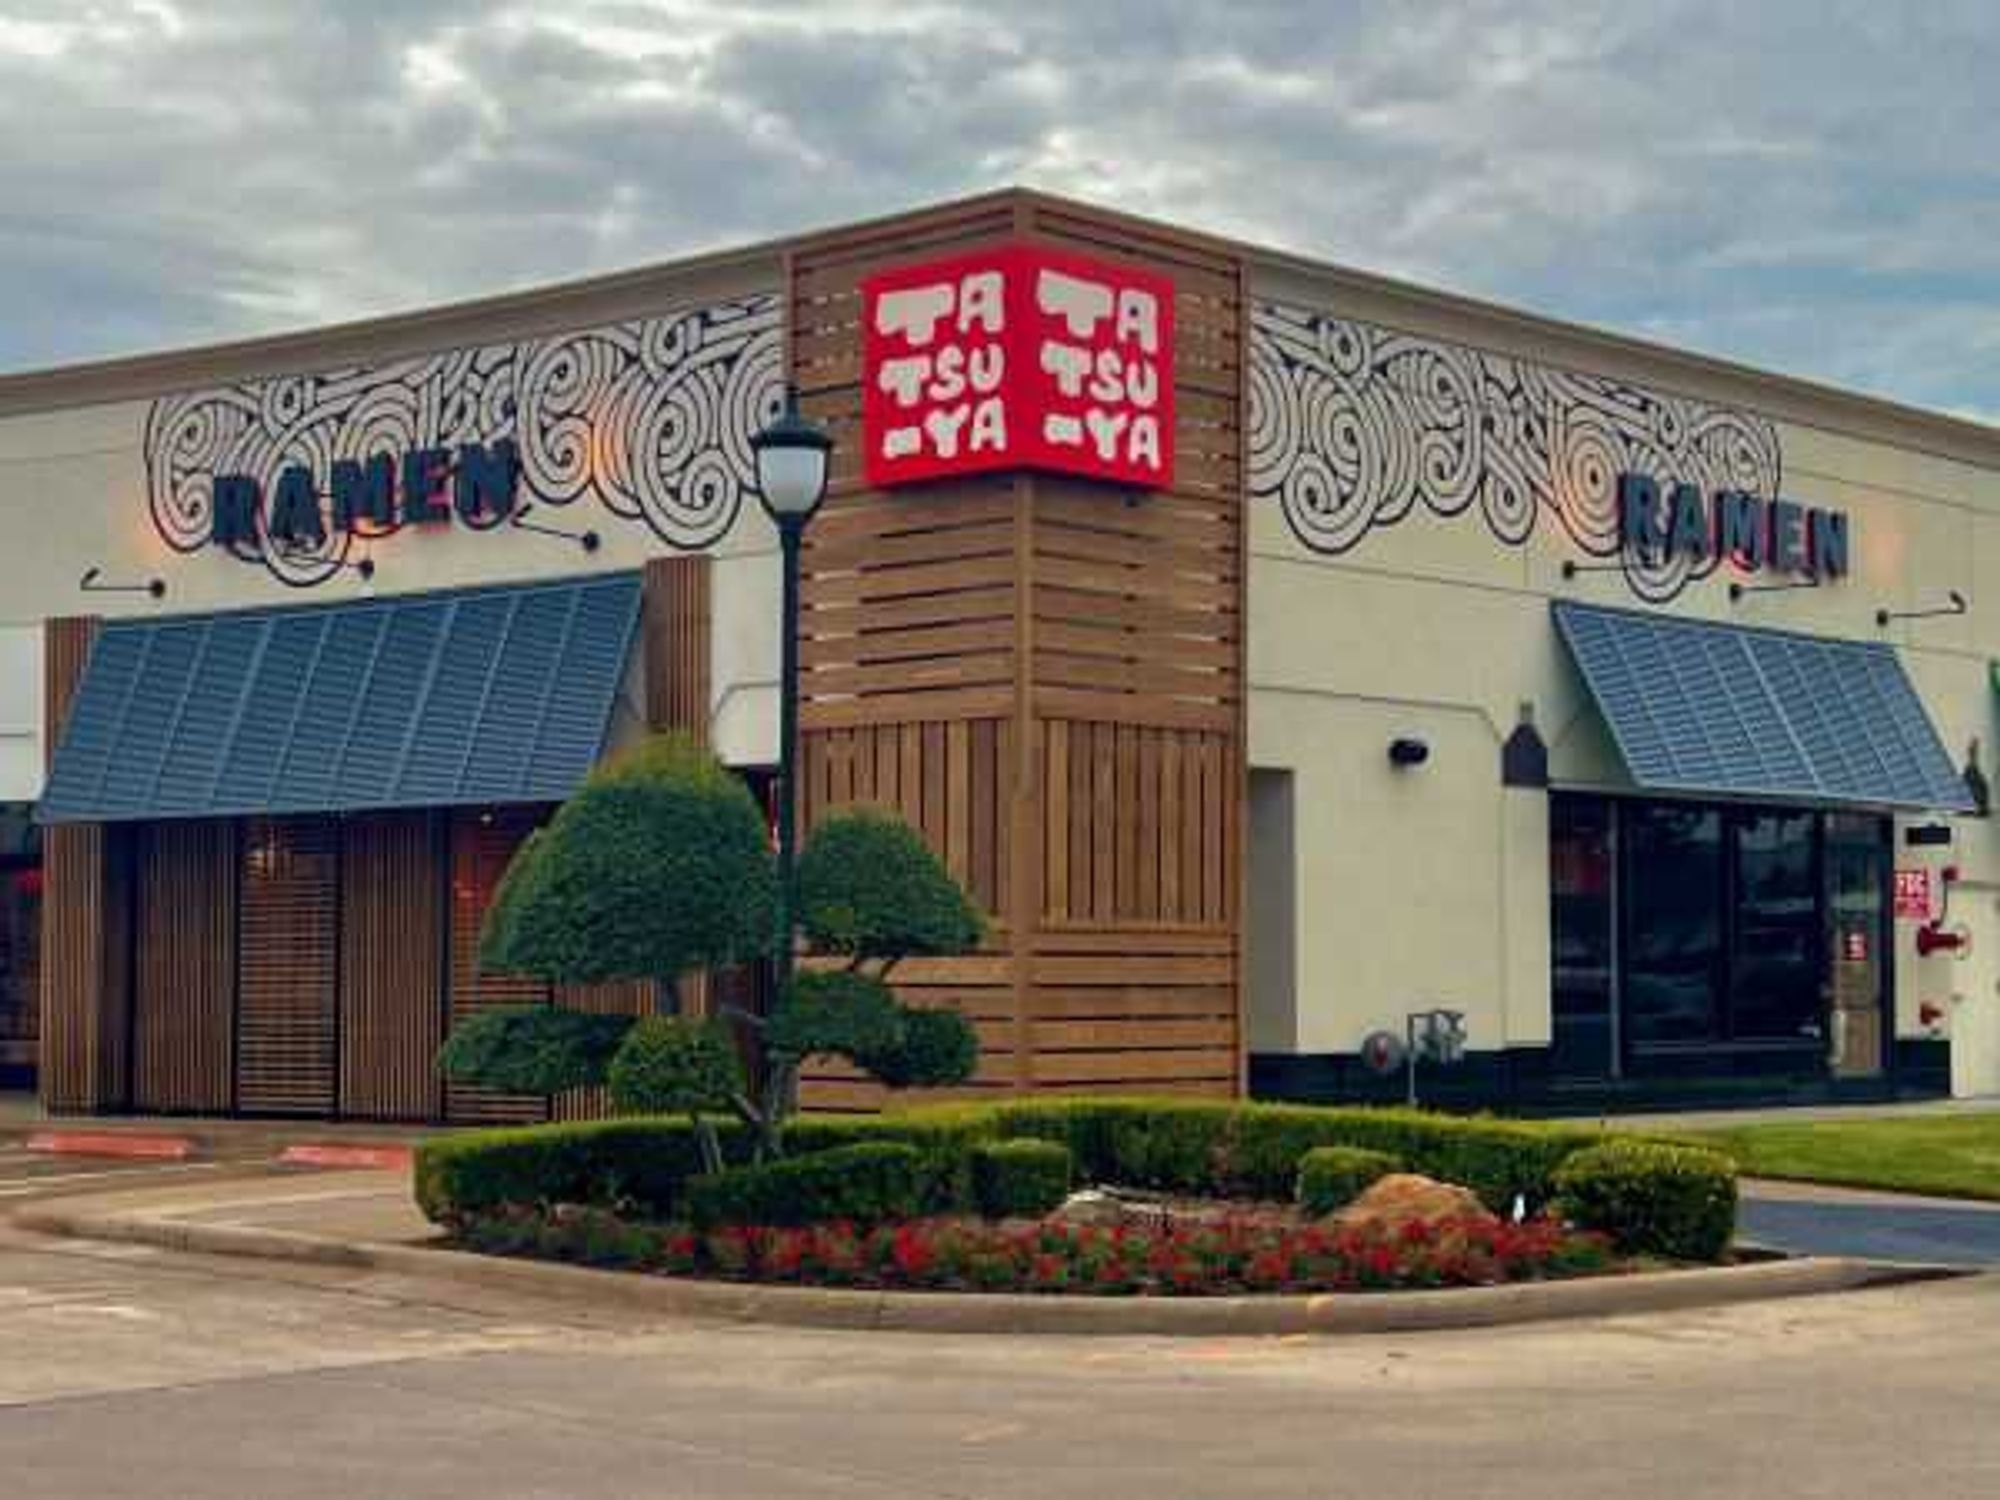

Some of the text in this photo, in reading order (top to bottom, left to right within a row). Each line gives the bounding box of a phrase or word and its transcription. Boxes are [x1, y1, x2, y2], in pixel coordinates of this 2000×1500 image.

[876, 271, 1004, 344] TA
[1037, 269, 1158, 353] TA
[878, 343, 1004, 406] TSU
[1040, 341, 1158, 407] TSU
[883, 397, 1006, 459] -YA
[1043, 409, 1161, 470] -YA
[214, 441, 517, 547] RAMEN
[1617, 472, 1848, 577] RAMEN
